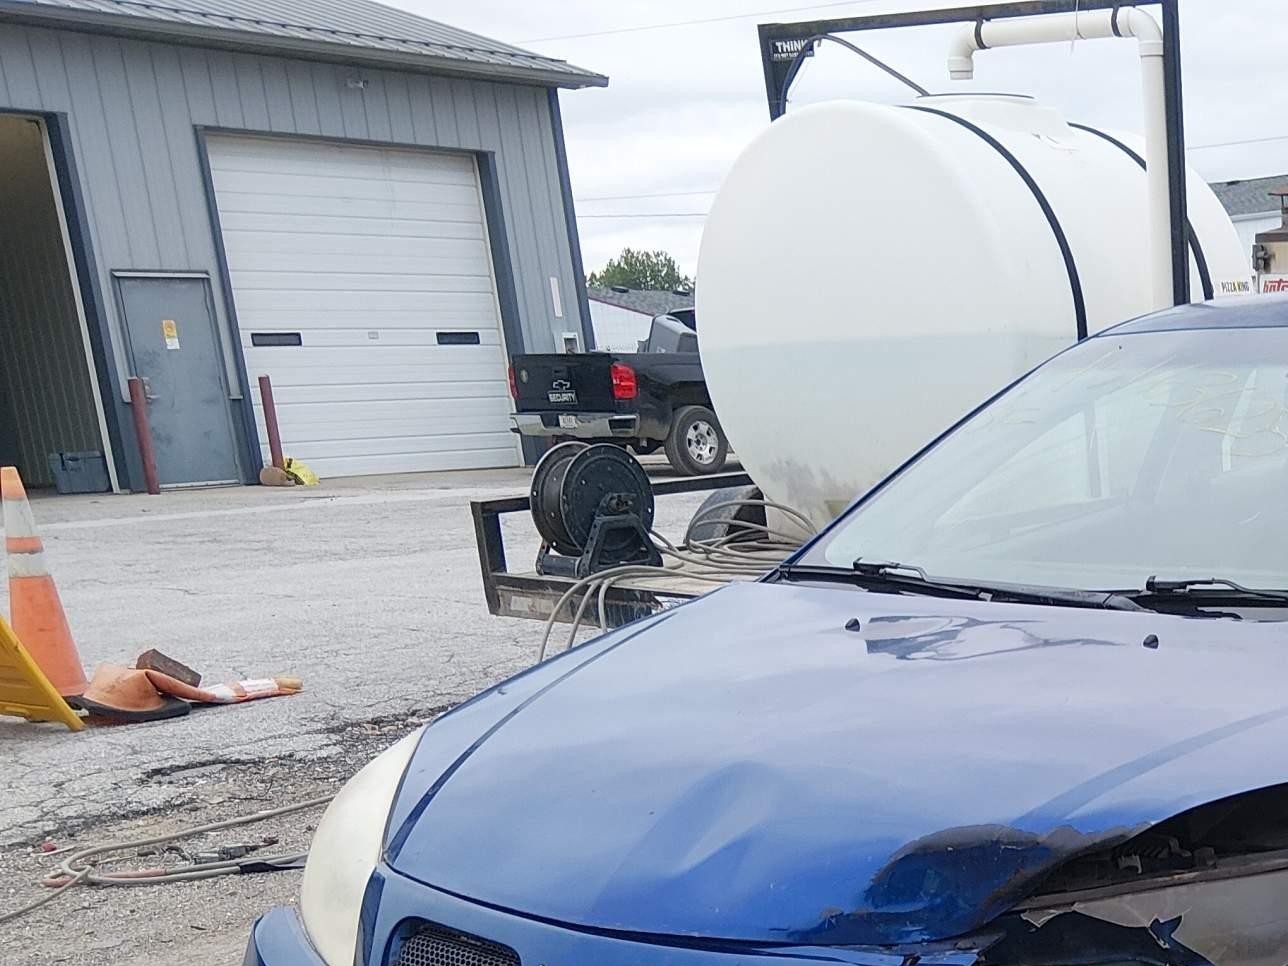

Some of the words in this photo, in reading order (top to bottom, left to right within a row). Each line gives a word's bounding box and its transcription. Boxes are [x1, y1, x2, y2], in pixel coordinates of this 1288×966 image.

[1221, 281, 1236, 293] PIZZA
[1236, 280, 1250, 292] KING
[548, 392, 577, 402] SECURITY
